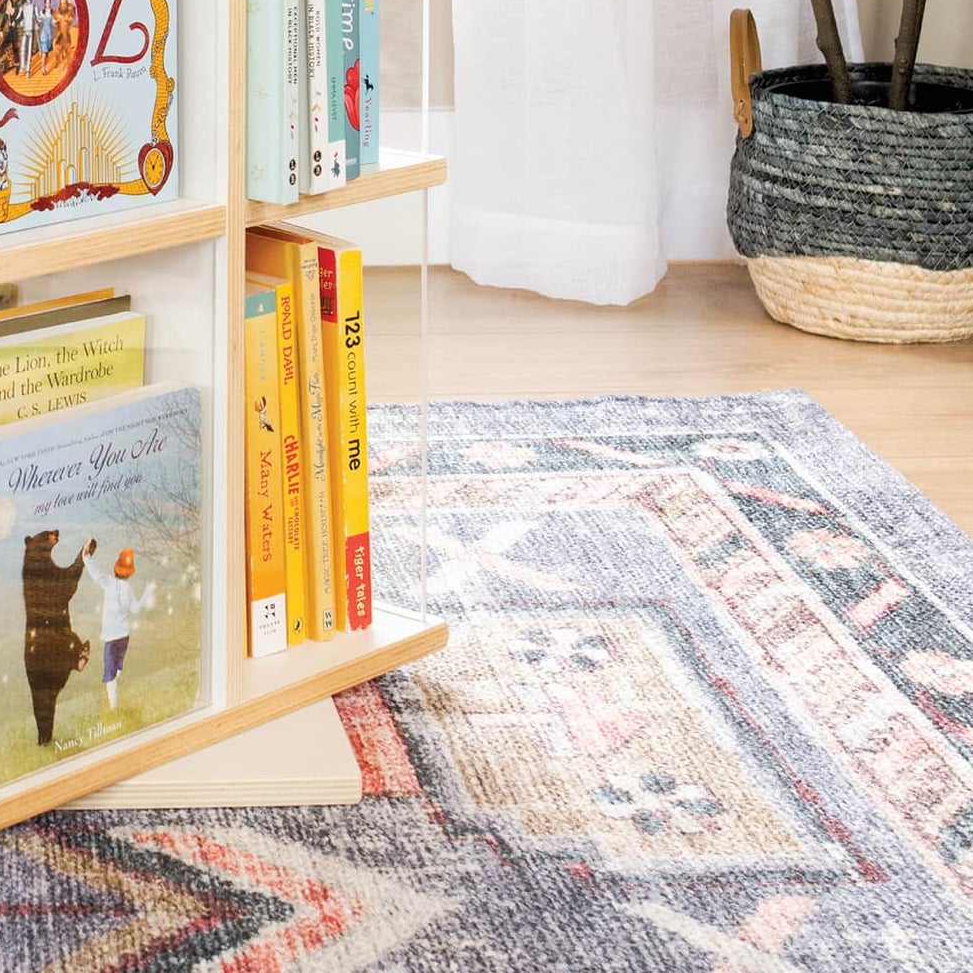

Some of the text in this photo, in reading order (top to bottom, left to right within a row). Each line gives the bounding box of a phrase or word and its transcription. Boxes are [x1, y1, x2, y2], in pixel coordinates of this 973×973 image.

[102, 66, 125, 79] Frank
[363, 96, 374, 148] Yearling
[15, 353, 52, 375] Lion,
[56, 343, 80, 365] the
[83, 334, 125, 358] Witch
[280, 295, 295, 386] ROALD DAHL
[20, 375, 43, 398] the
[46, 362, 115, 389] Wardrobe
[345, 310, 361, 471] 123 count with me
[16, 391, 88, 420] C. S. LEWIS
[8, 461, 83, 495] Wherever
[87, 440, 128, 482] You
[131, 427, 169, 461] Are
[283, 434, 300, 495] CHARLIE
[33, 474, 144, 518] my love will find you
[257, 450, 273, 563] Many Waters
[292, 507, 301, 551] CHOCOLATE
[353, 545, 367, 617] tiger tales
[54, 720, 123, 754] Nancy Tillman
